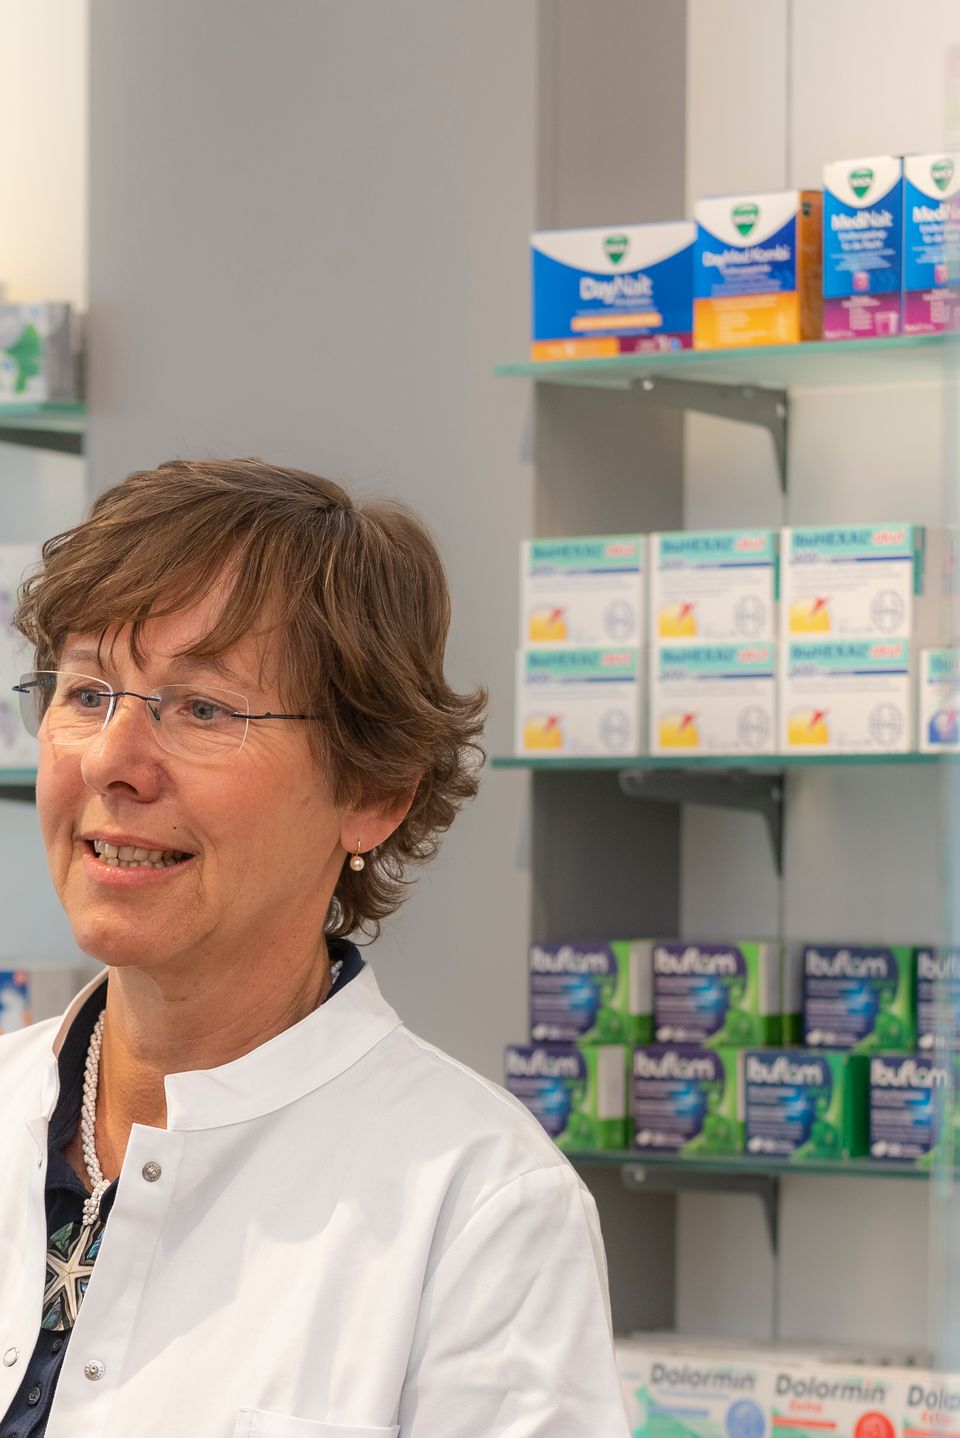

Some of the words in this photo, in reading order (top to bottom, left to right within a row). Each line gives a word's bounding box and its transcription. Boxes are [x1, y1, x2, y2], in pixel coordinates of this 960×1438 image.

[531, 945, 610, 974] Ibuflam
[654, 946, 738, 975] Ibuflam
[805, 949, 888, 978] Ibuflam
[508, 1048, 581, 1077] Ibuflam
[634, 1050, 716, 1079] Ibuflam
[746, 1056, 824, 1085] Ibuflam
[870, 1057, 948, 1087] Ibuflam
[649, 1361, 756, 1391] Dolormin
[775, 1372, 887, 1405] Dolormin
